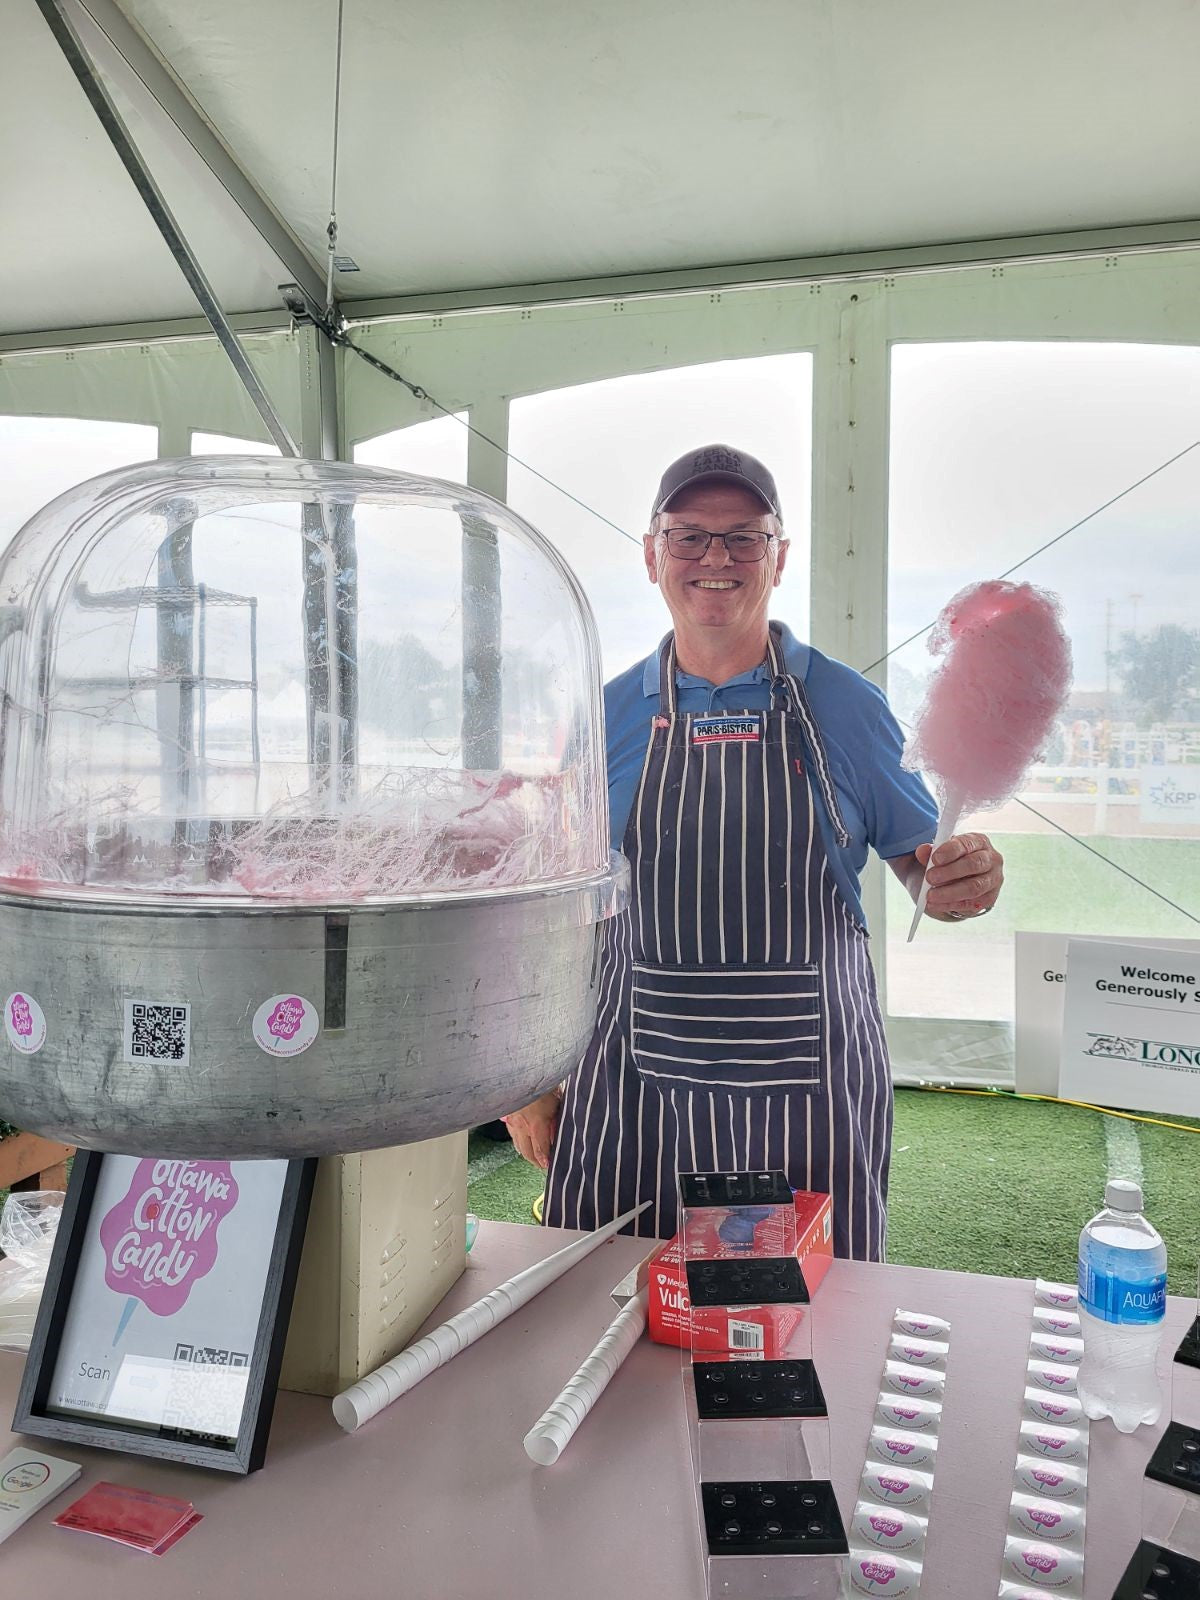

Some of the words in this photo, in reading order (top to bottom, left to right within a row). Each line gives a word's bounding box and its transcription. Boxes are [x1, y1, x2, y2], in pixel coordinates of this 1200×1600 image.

[1164, 791, 1200, 804] KRP
[1120, 965, 1196, 985] Welcome
[1095, 979, 1188, 1003] Generously
[1142, 1041, 1200, 1066] LON
[151, 1160, 230, 1202] Ottawa
[111, 1231, 195, 1286] Candy
[658, 1287, 689, 1312] Vulc
[78, 1361, 111, 1381] Scan
